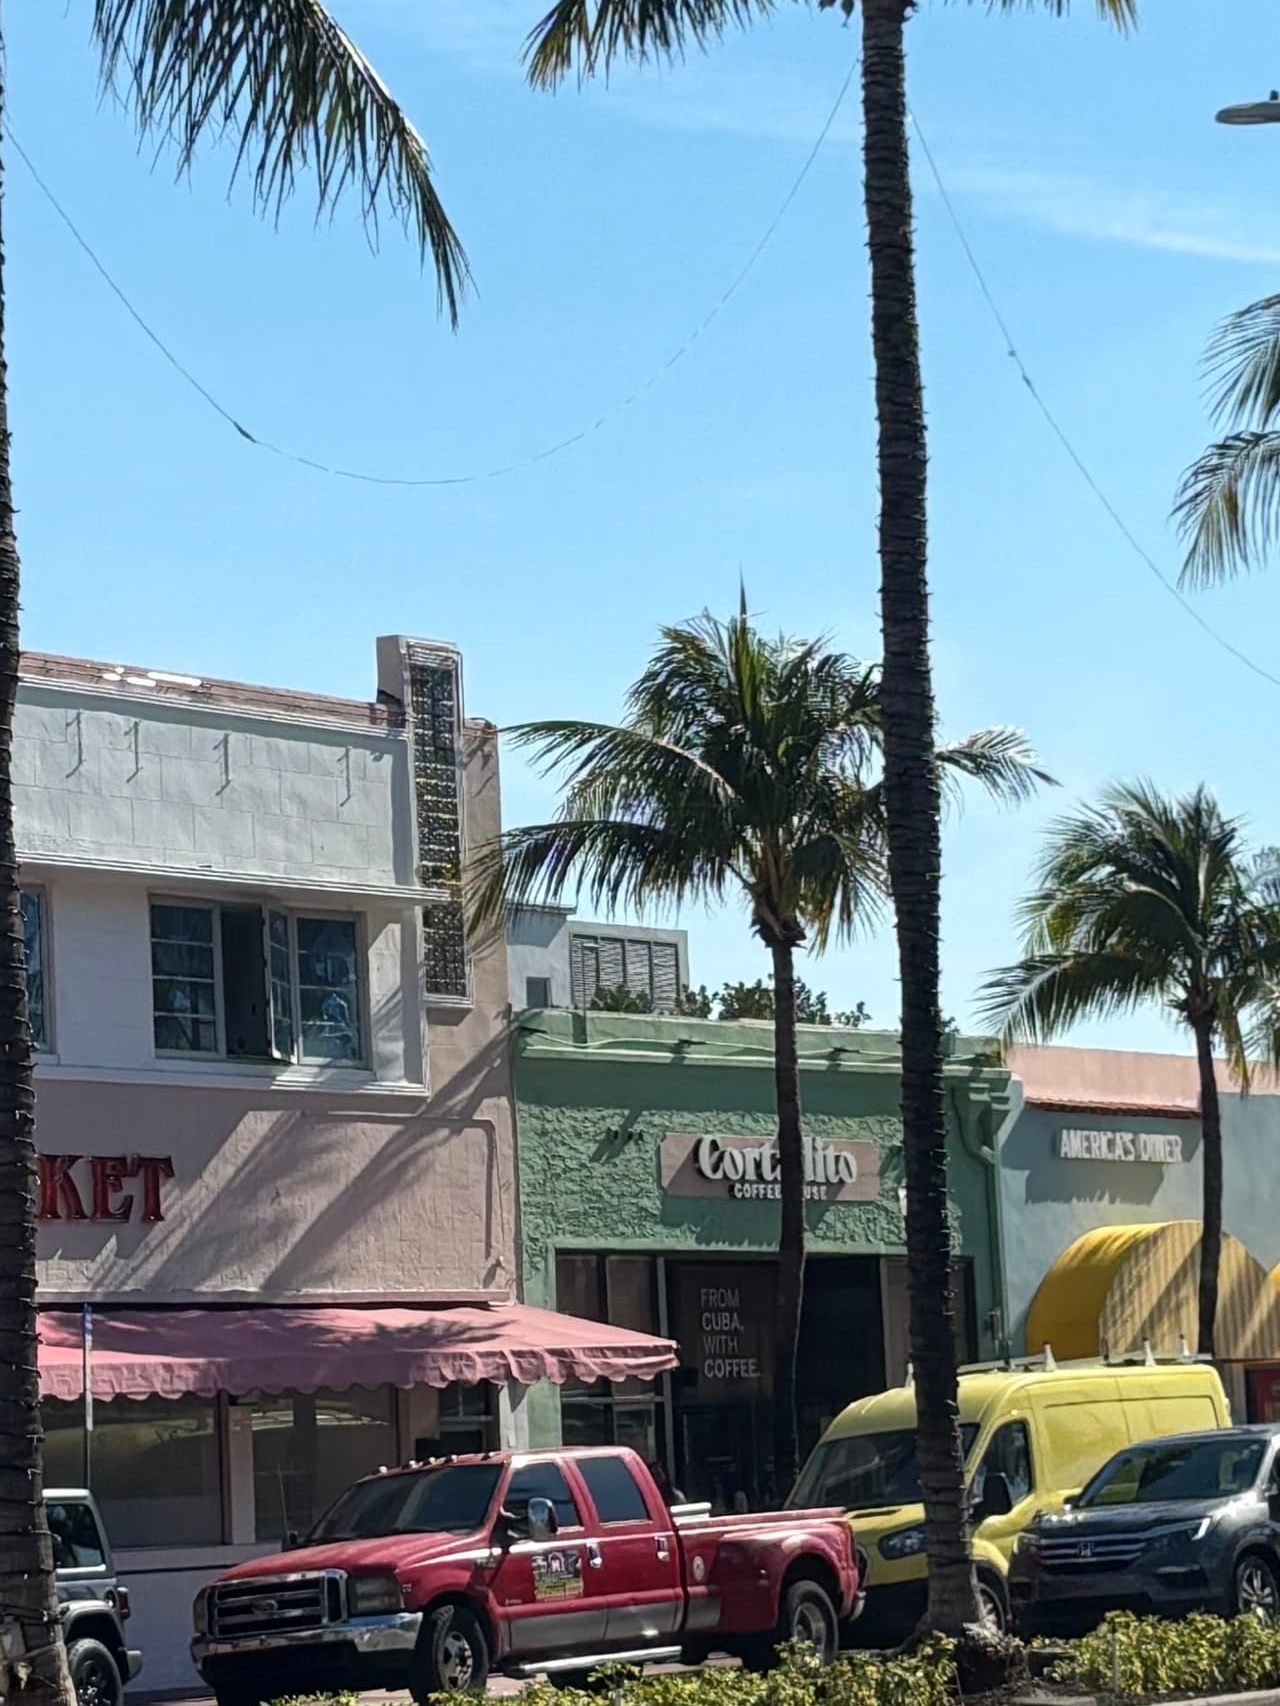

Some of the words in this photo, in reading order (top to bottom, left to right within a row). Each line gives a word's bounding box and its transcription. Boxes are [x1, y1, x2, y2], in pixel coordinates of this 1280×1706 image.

[700, 1288, 740, 1307] FROM
[702, 1312, 744, 1332] CUBA,
[703, 1335, 738, 1354] WITH
